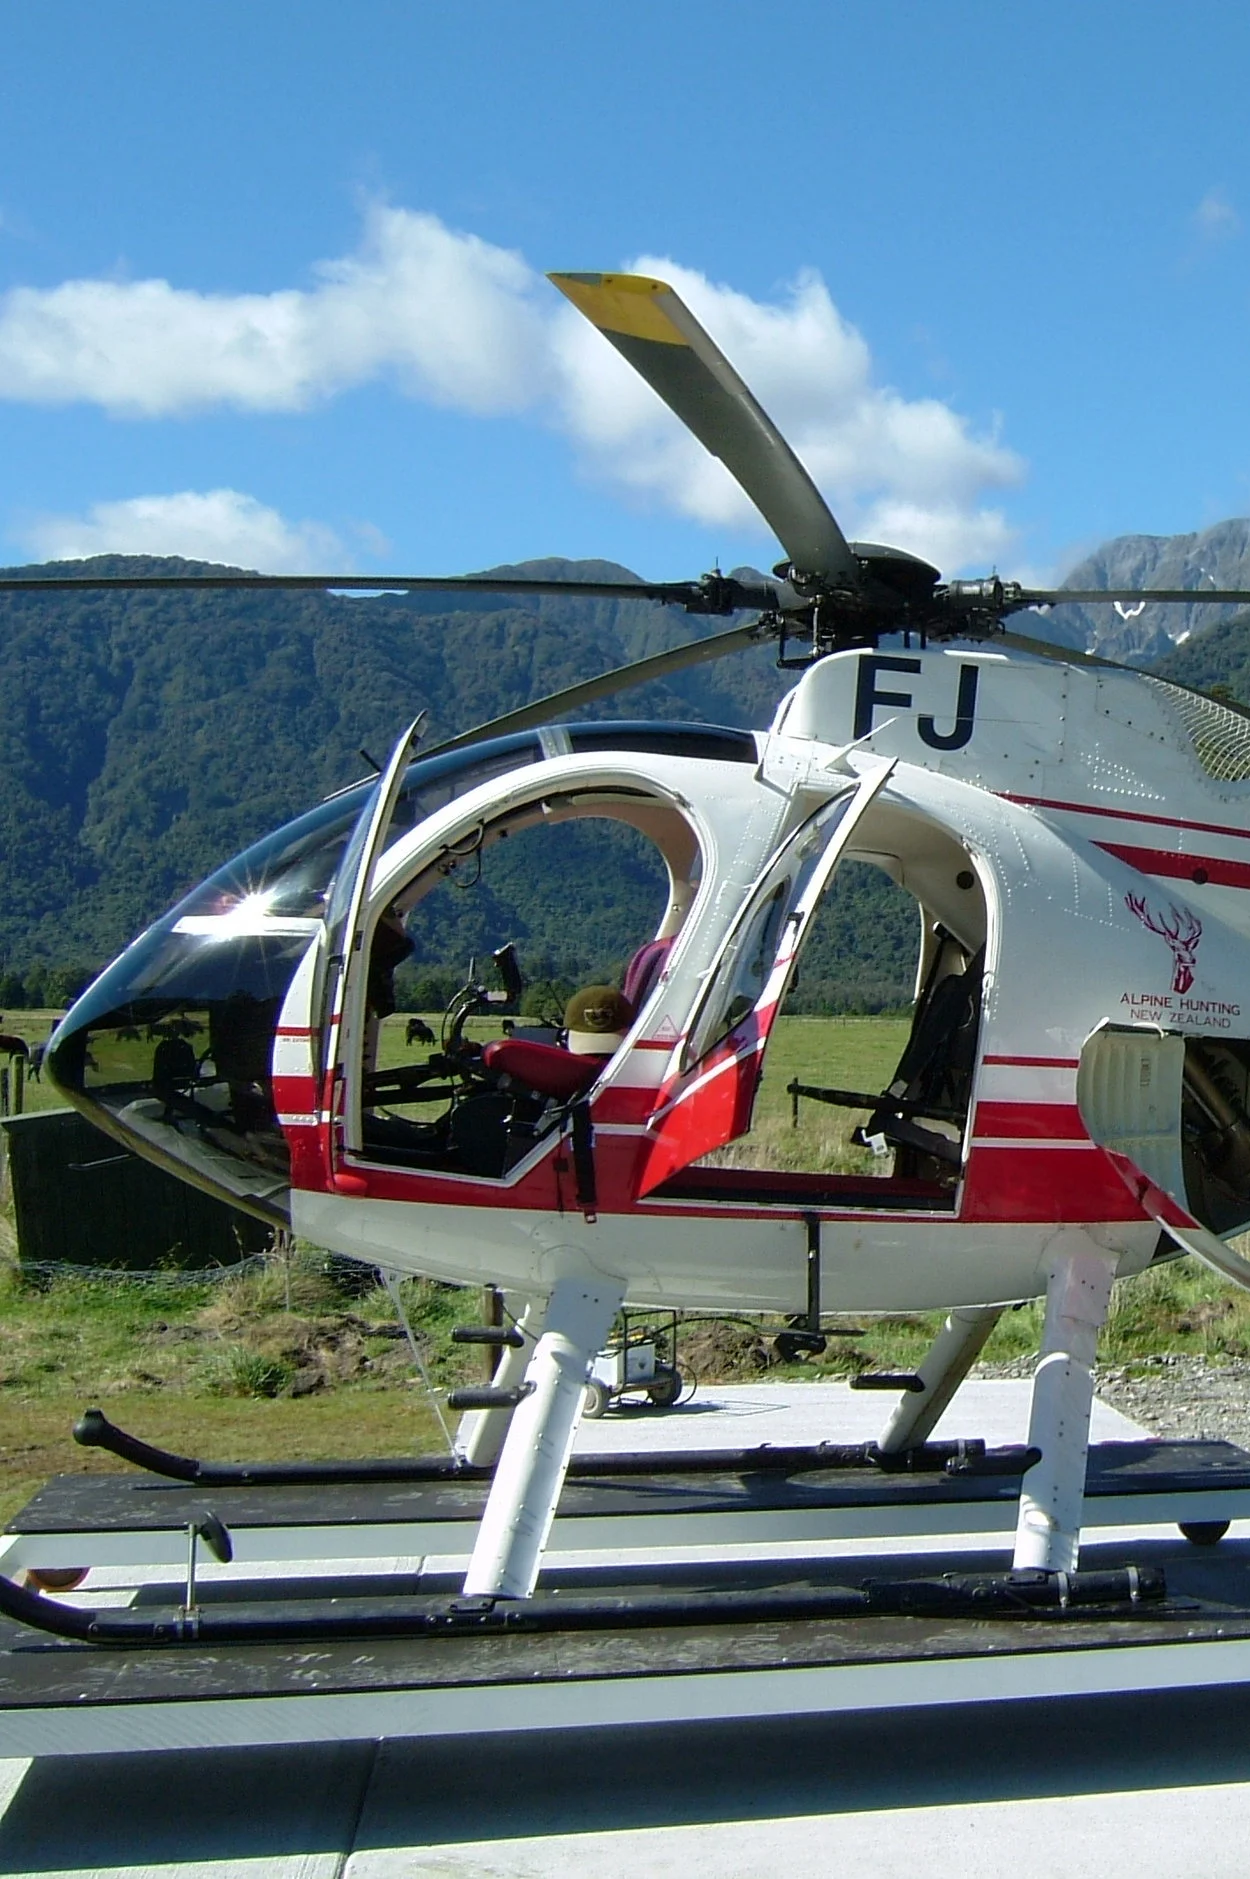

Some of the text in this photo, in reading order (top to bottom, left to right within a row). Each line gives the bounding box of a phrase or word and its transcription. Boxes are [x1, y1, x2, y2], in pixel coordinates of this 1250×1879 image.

[854, 655, 979, 750] FJ
[1120, 992, 1241, 1016] ALPINE HUNTING
[1130, 1009, 1231, 1029] NEW ZEALAND
